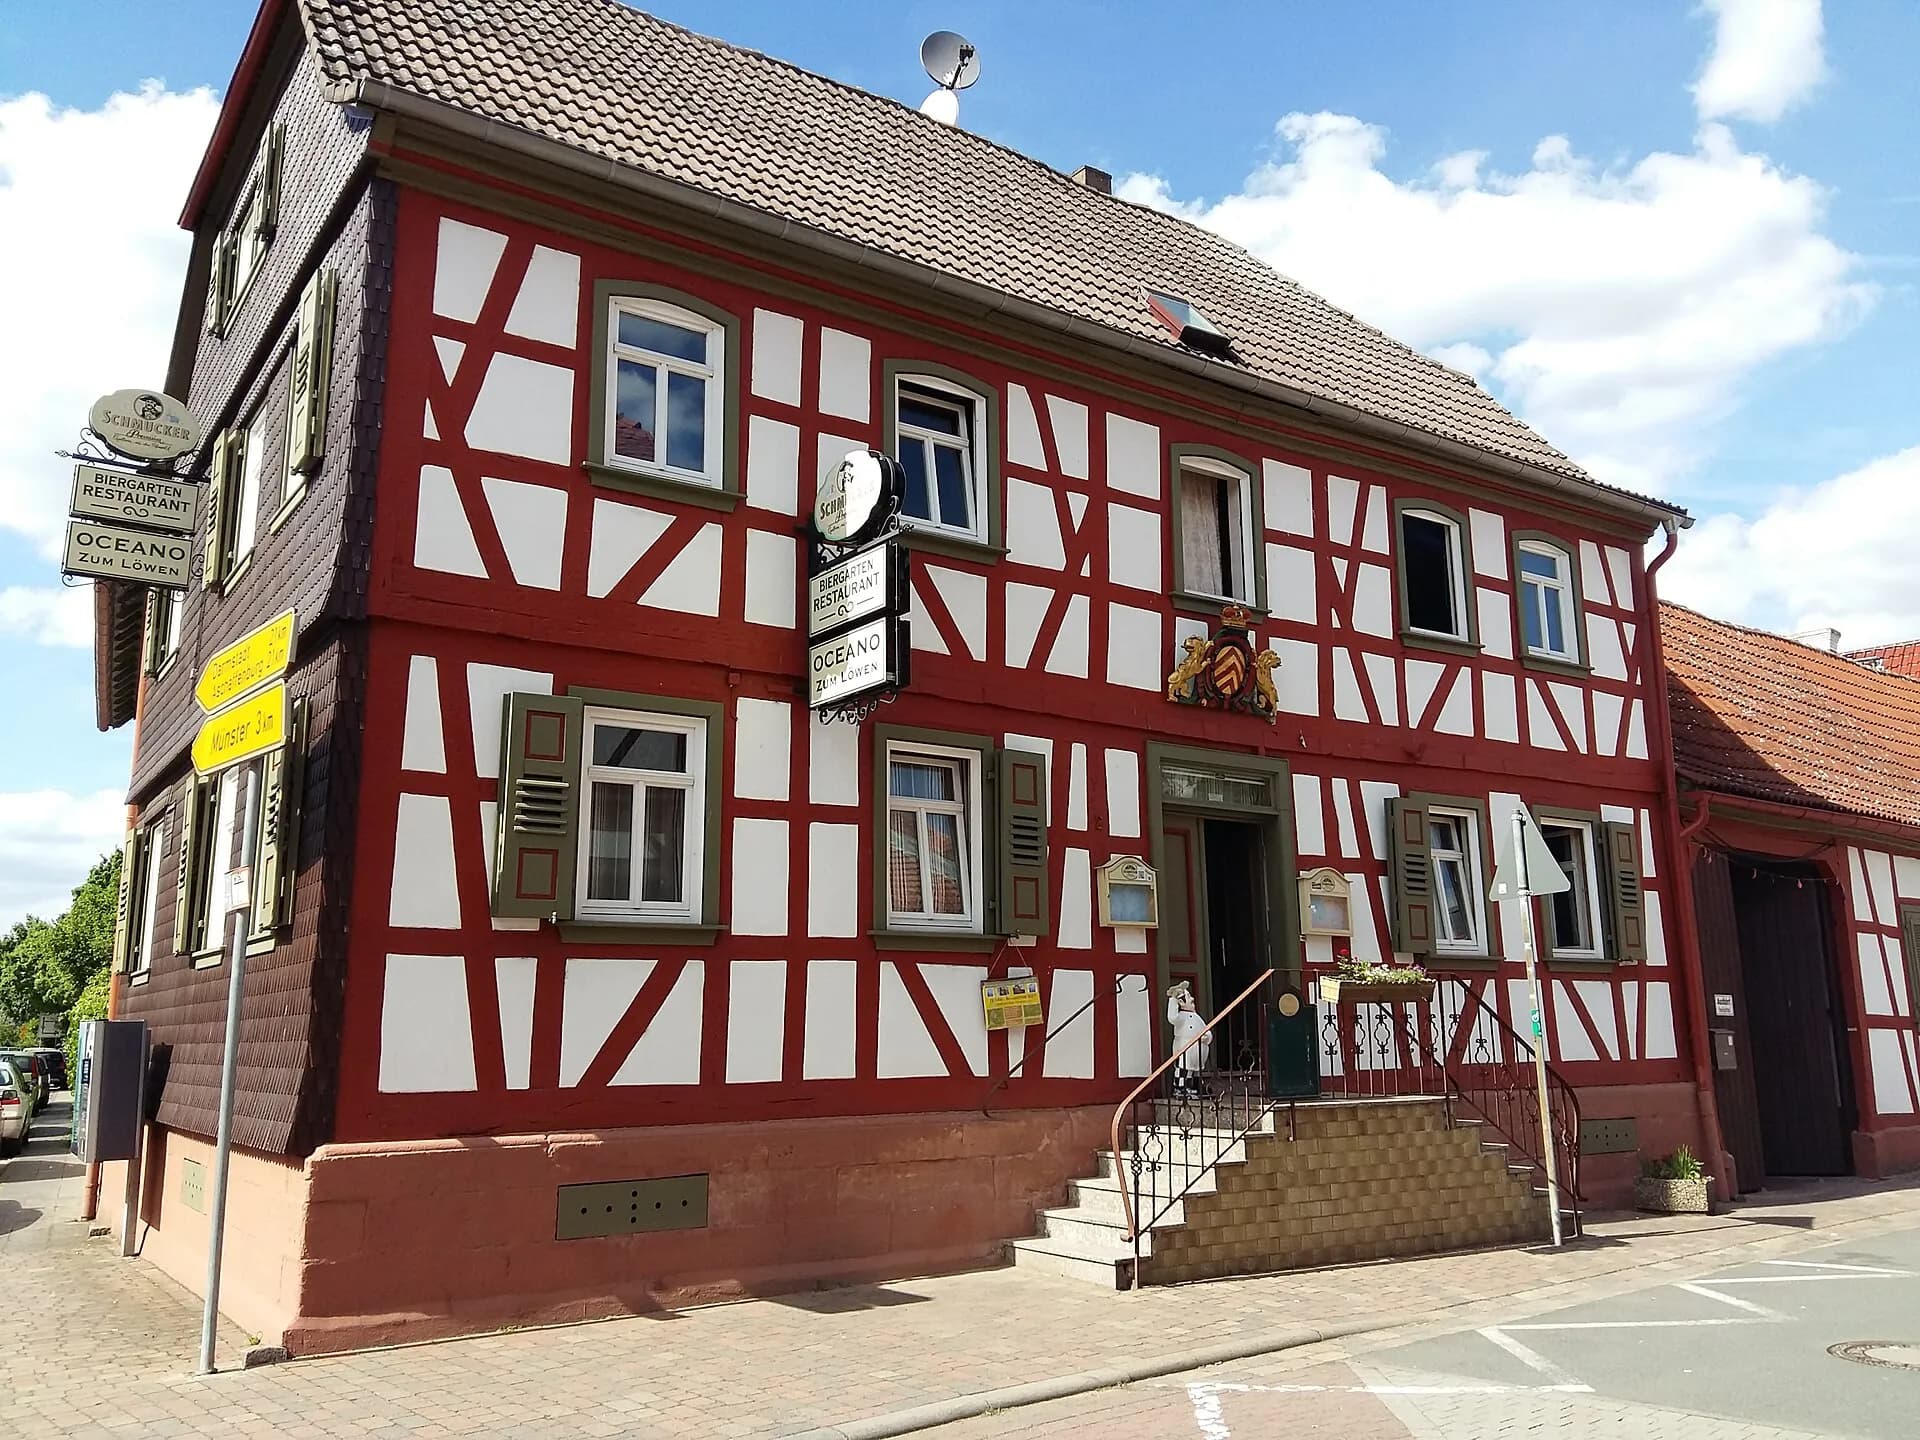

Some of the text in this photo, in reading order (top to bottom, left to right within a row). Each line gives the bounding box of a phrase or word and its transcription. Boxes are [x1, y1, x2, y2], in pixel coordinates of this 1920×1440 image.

[102, 409, 190, 440] SCHMUCKER
[83, 484, 191, 513] RESTAURANT
[94, 473, 182, 498] BIERGARTEN
[76, 532, 185, 560] OCEANO
[78, 552, 179, 576] ZUM LÖWEN
[819, 559, 874, 593] BIERGARTEN
[813, 572, 880, 613] RESTAURANT
[212, 645, 251, 680] Darmstadt
[813, 633, 880, 672] OCEANO
[212, 659, 263, 698] Aschaffenburg
[815, 677, 837, 692] ZUM
[210, 710, 274, 754] Münster 3 km
